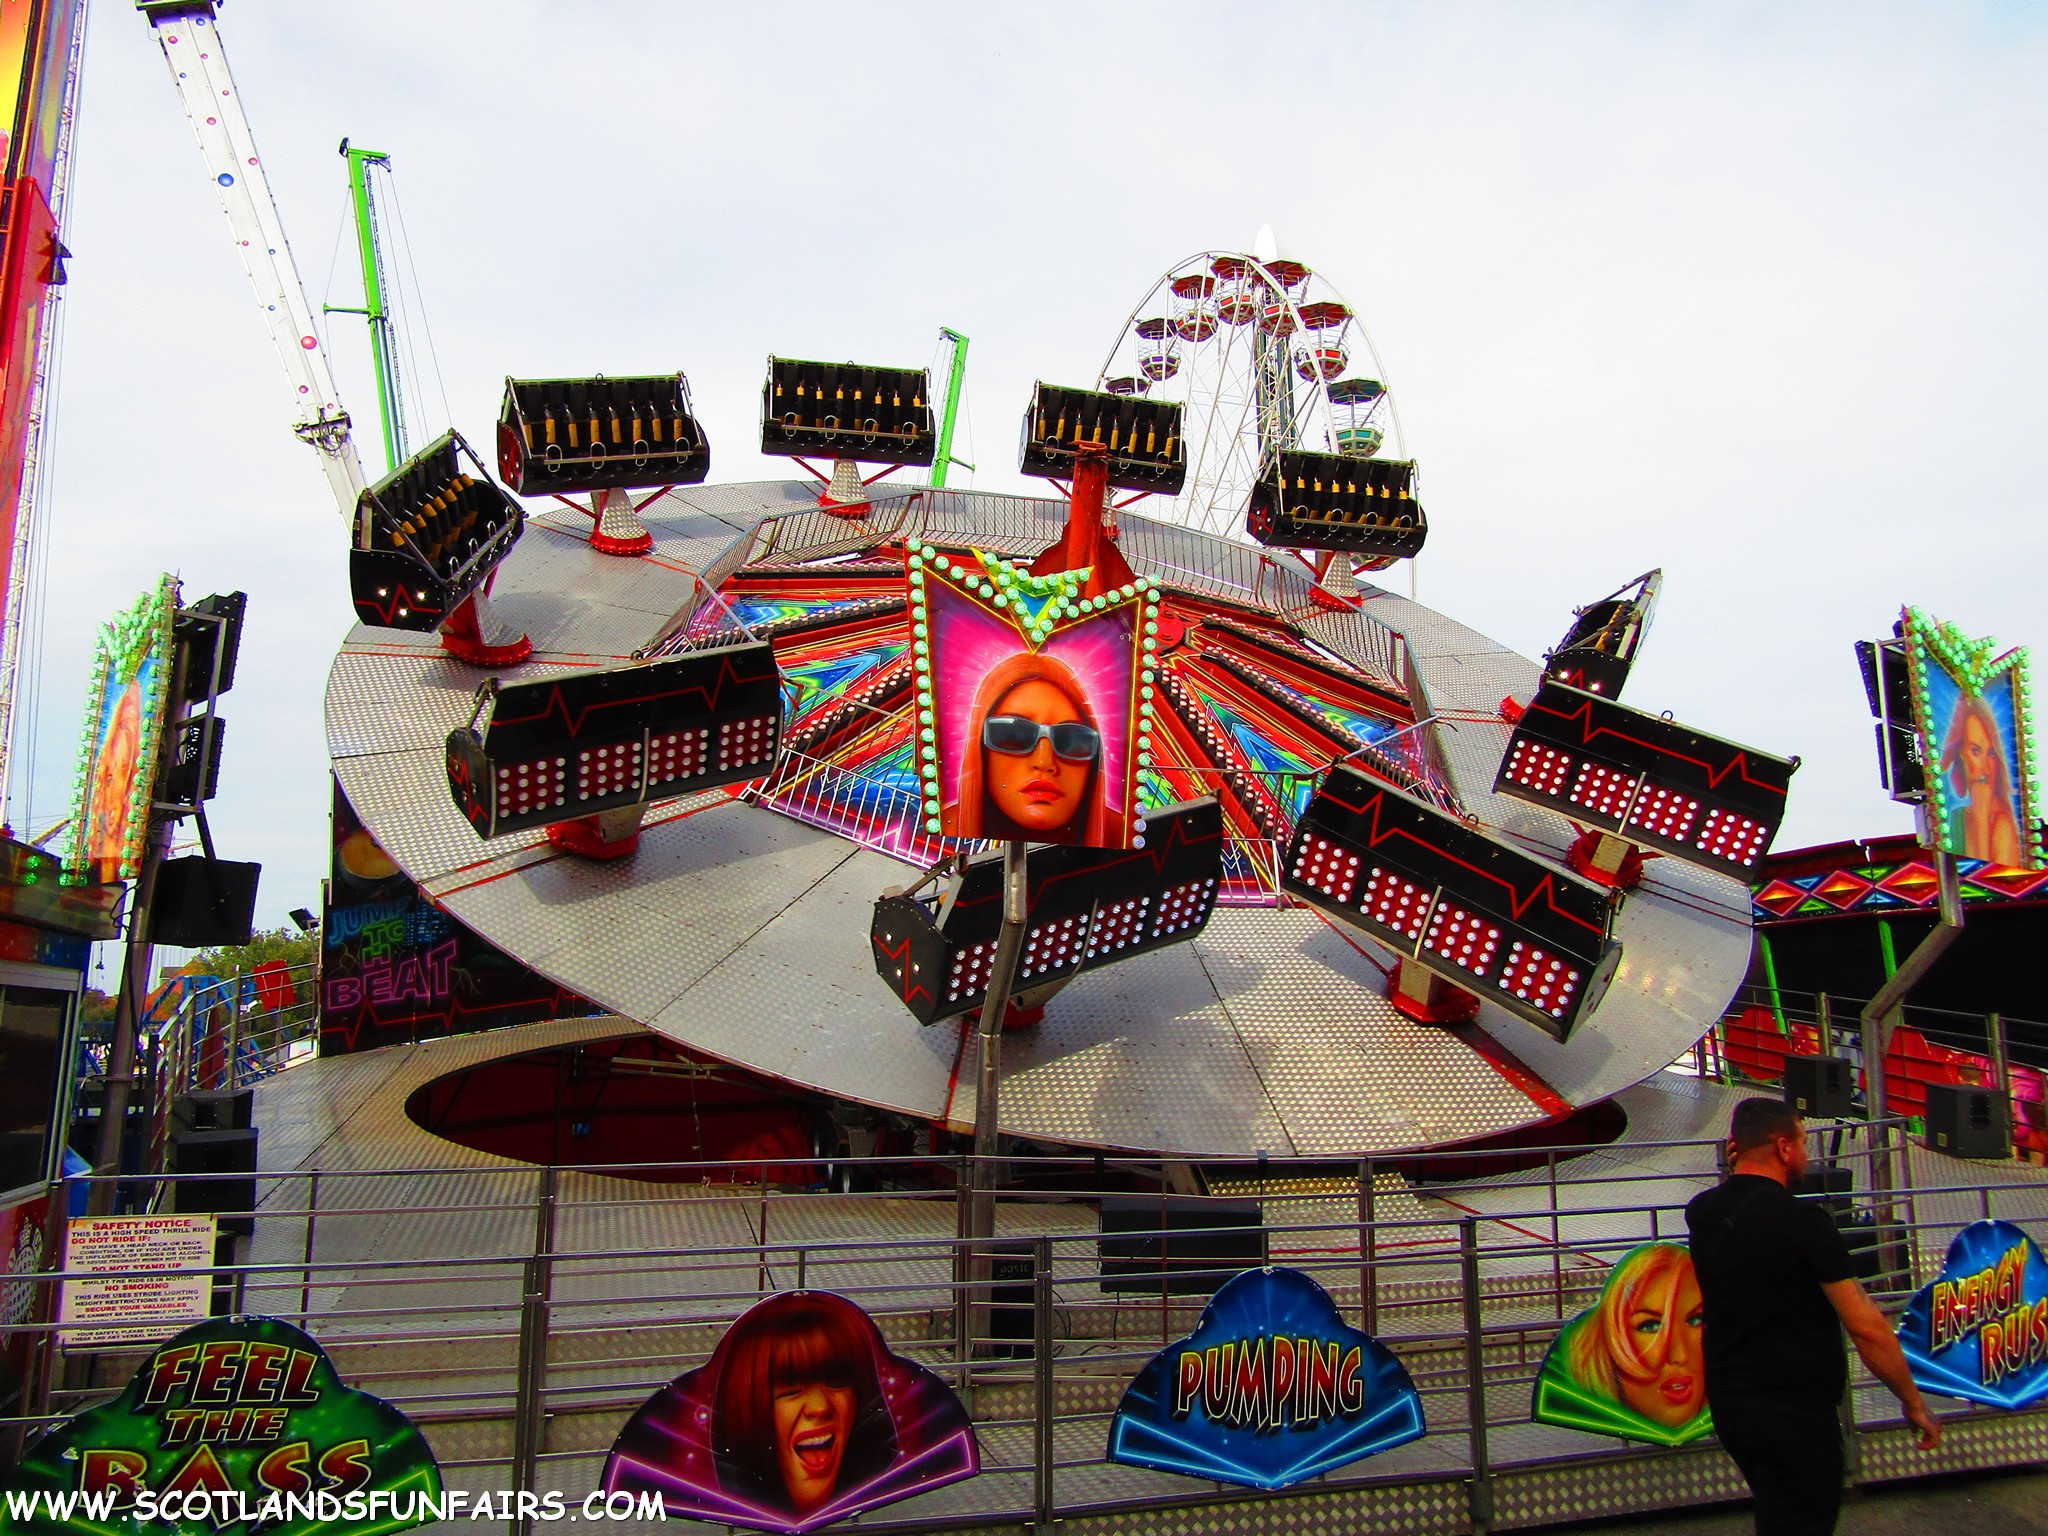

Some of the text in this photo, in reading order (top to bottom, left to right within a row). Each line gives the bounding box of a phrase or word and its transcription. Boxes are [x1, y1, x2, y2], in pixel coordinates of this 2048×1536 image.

[327, 939, 457, 1010] BEAT
[92, 1220, 192, 1230] SAFETY NOTICE
[1932, 1237, 2029, 1351] ENERGY
[143, 1340, 320, 1405] FEEL
[1981, 1296, 2048, 1385] RUS
[1177, 1336, 1363, 1427] PUMPING
[165, 1408, 289, 1443] THE
[78, 1439, 372, 1532] BASS
